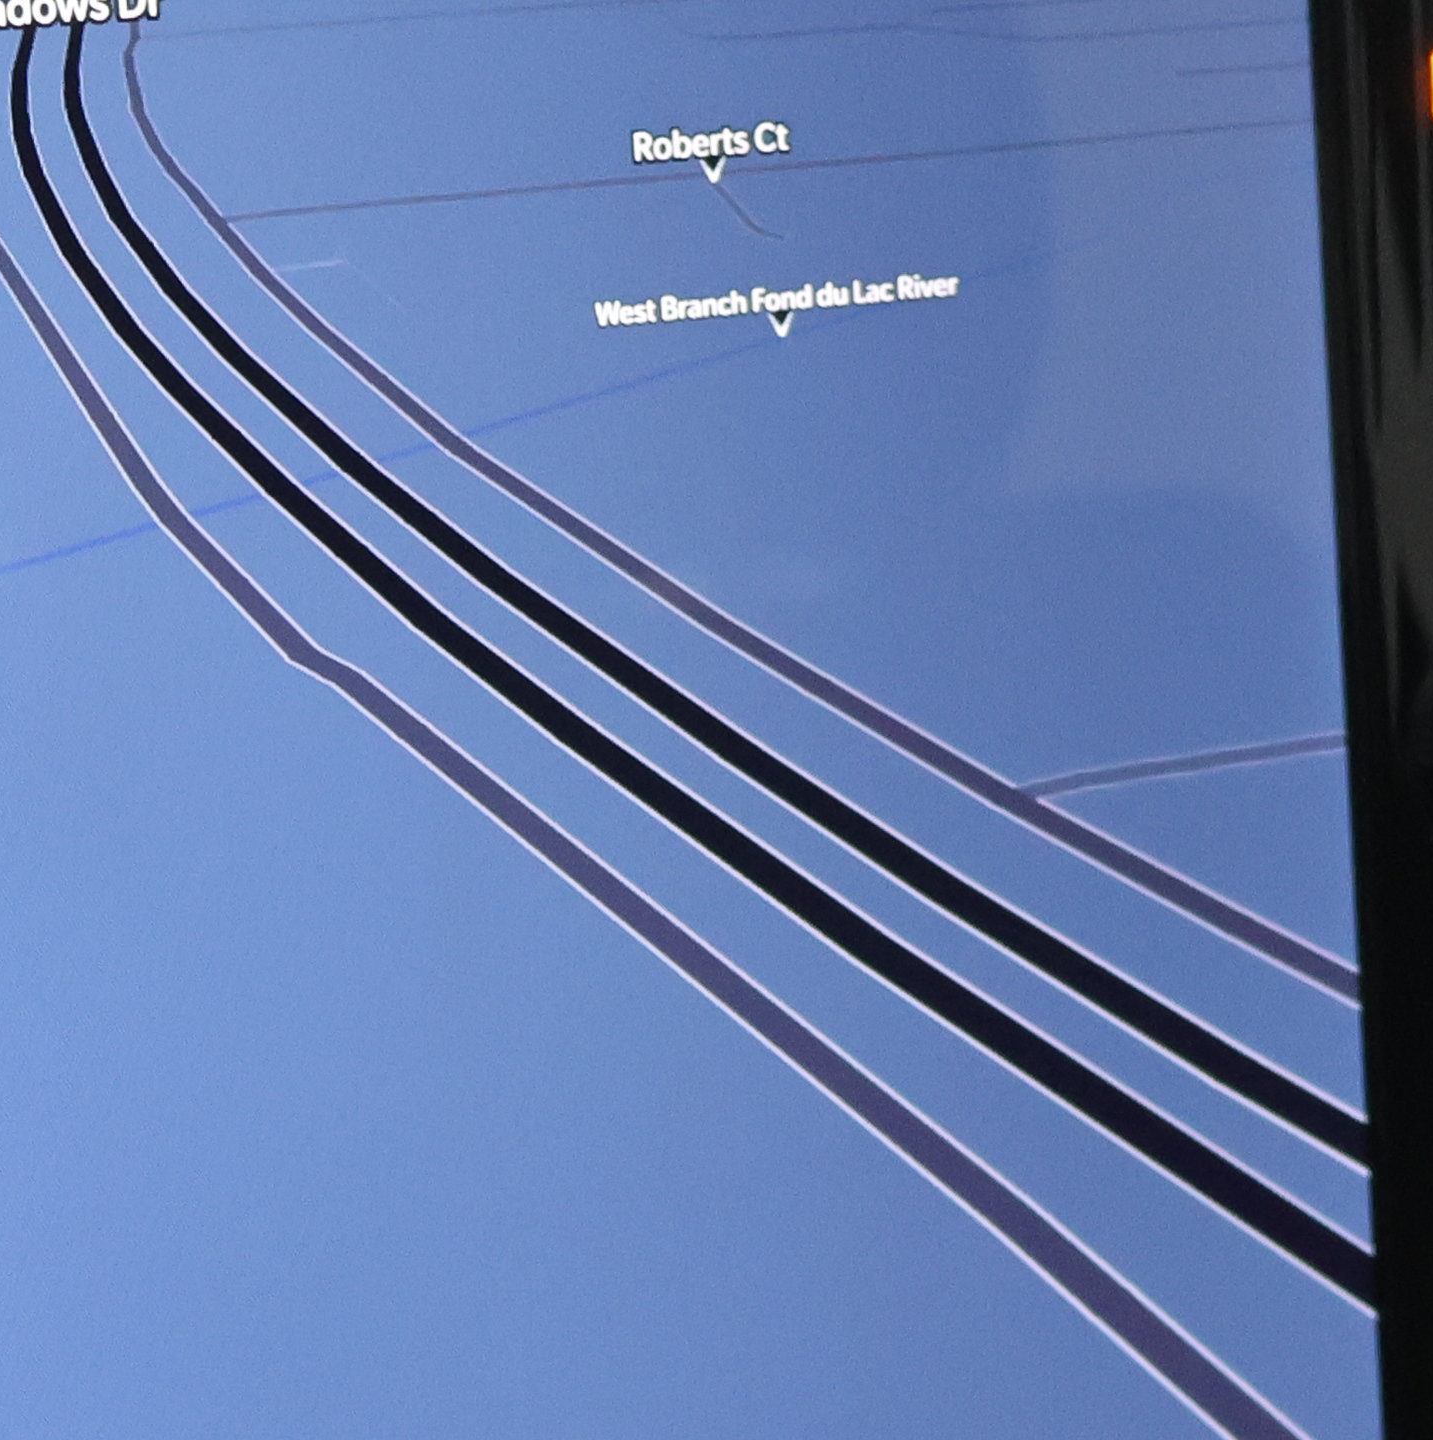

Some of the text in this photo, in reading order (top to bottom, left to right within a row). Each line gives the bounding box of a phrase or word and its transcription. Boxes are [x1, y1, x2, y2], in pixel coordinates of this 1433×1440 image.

[632, 122, 790, 163] Roberts Ct
[595, 274, 960, 327] West Branch Fond du Lac River
